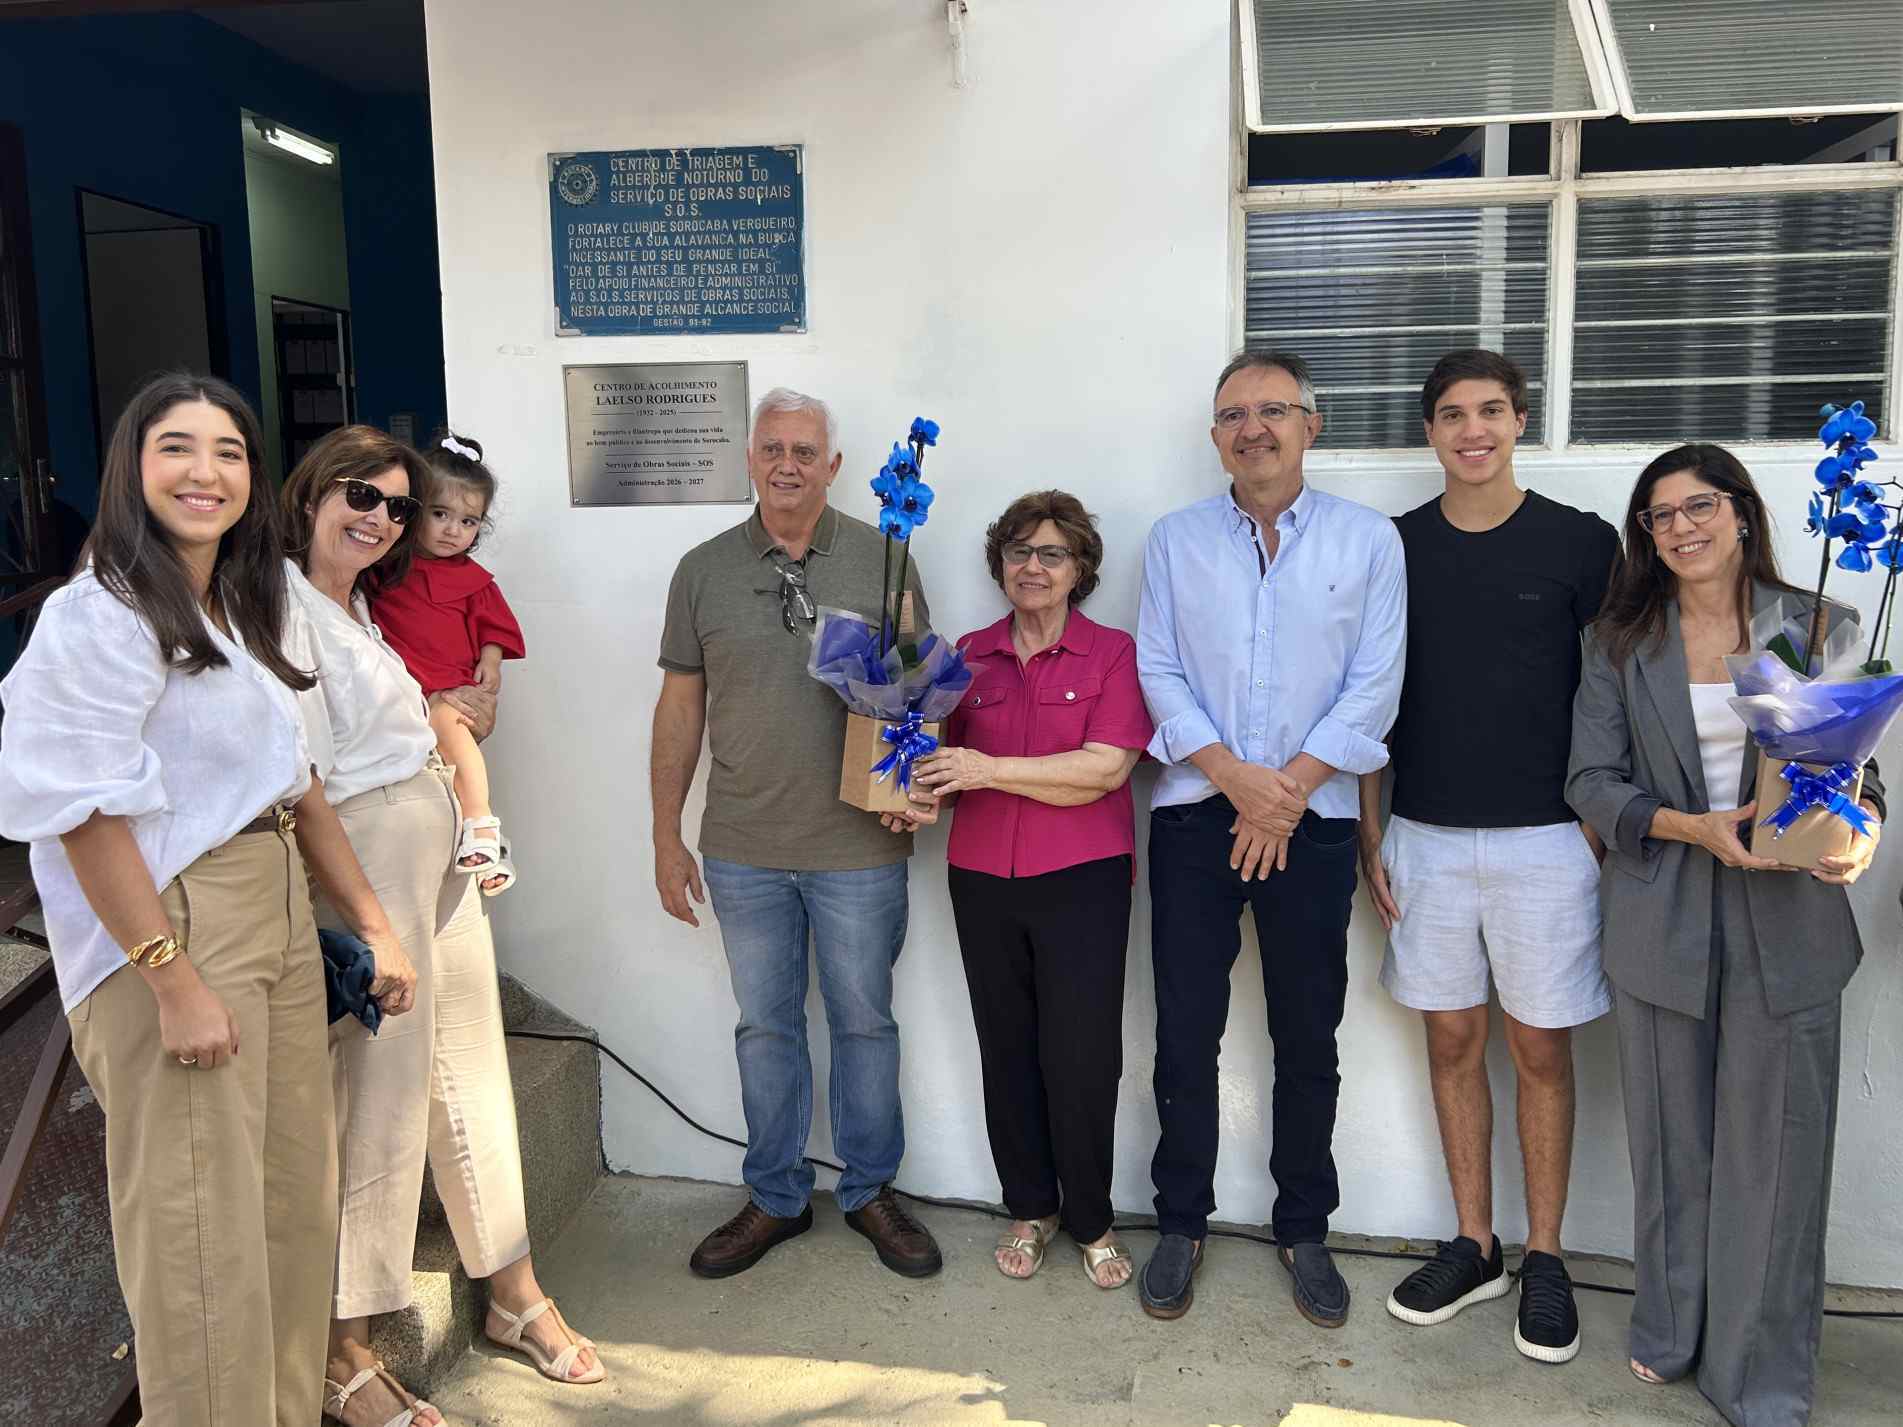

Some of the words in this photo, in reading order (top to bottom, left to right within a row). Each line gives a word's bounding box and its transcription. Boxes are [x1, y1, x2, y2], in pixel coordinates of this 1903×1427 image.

[610, 157, 660, 171] CENTRO
[665, 156, 682, 170] DE
[687, 155, 743, 170] TRIAGEM
[748, 154, 759, 168] E
[610, 171, 677, 187] ALBERGUE
[684, 170, 743, 185] NOTURNO
[752, 168, 768, 182] DO
[610, 188, 664, 205] SERVIÇO
[669, 188, 686, 202] DE
[689, 186, 734, 202] OBRAS
[739, 184, 791, 200] SOCIAIS
[664, 203, 702, 217] S.O.S.
[567, 223, 575, 235] O
[578, 222, 619, 235] ROTARY
[622, 222, 649, 234] CLUB
[652, 220, 667, 232] DE
[670, 218, 729, 233] SOROCABA
[568, 236, 631, 249] FORTALECE
[635, 237, 643, 247] A
[646, 235, 670, 247] SUA
[740, 233, 754, 245] NA
[758, 232, 796, 244] BUSCA
[569, 251, 640, 263] INCESSANTE
[642, 250, 656, 262] DO
[660, 249, 682, 261] SEU
[688, 248, 734, 260] GRANDE
[598, 264, 612, 277] DE
[616, 264, 627, 276] SI
[631, 264, 668, 276] ANTES
[673, 264, 688, 276] DE
[693, 263, 738, 275] PENSAR
[742, 263, 759, 274] EM
[569, 278, 596, 290] PELO
[598, 278, 629, 289] APOIO
[631, 276, 695, 289] FINANCEIRO
[698, 276, 705, 287] E
[706, 274, 799, 288] ADMINISTRATIVO
[570, 291, 584, 303] AO
[684, 289, 698, 301] DE
[701, 289, 739, 301] OBRAS
[571, 305, 605, 317] NESTA
[608, 305, 637, 316] OBRA
[639, 305, 654, 316] DE
[656, 303, 702, 316] GRANDE
[704, 302, 755, 315] ALCANCE
[757, 301, 796, 314] SOCIAL
[593, 383, 632, 392] CENTRO
[634, 382, 646, 391] DE
[648, 381, 718, 391] ACOLHIMENTO
[596, 395, 643, 406] LAELSO
[646, 393, 717, 405] RODRIGUES
[605, 462, 632, 470] Serviço
[642, 460, 665, 468] Obras
[697, 459, 714, 467] SOS
[617, 480, 665, 488] Administração
[666, 478, 681, 486] 2026
